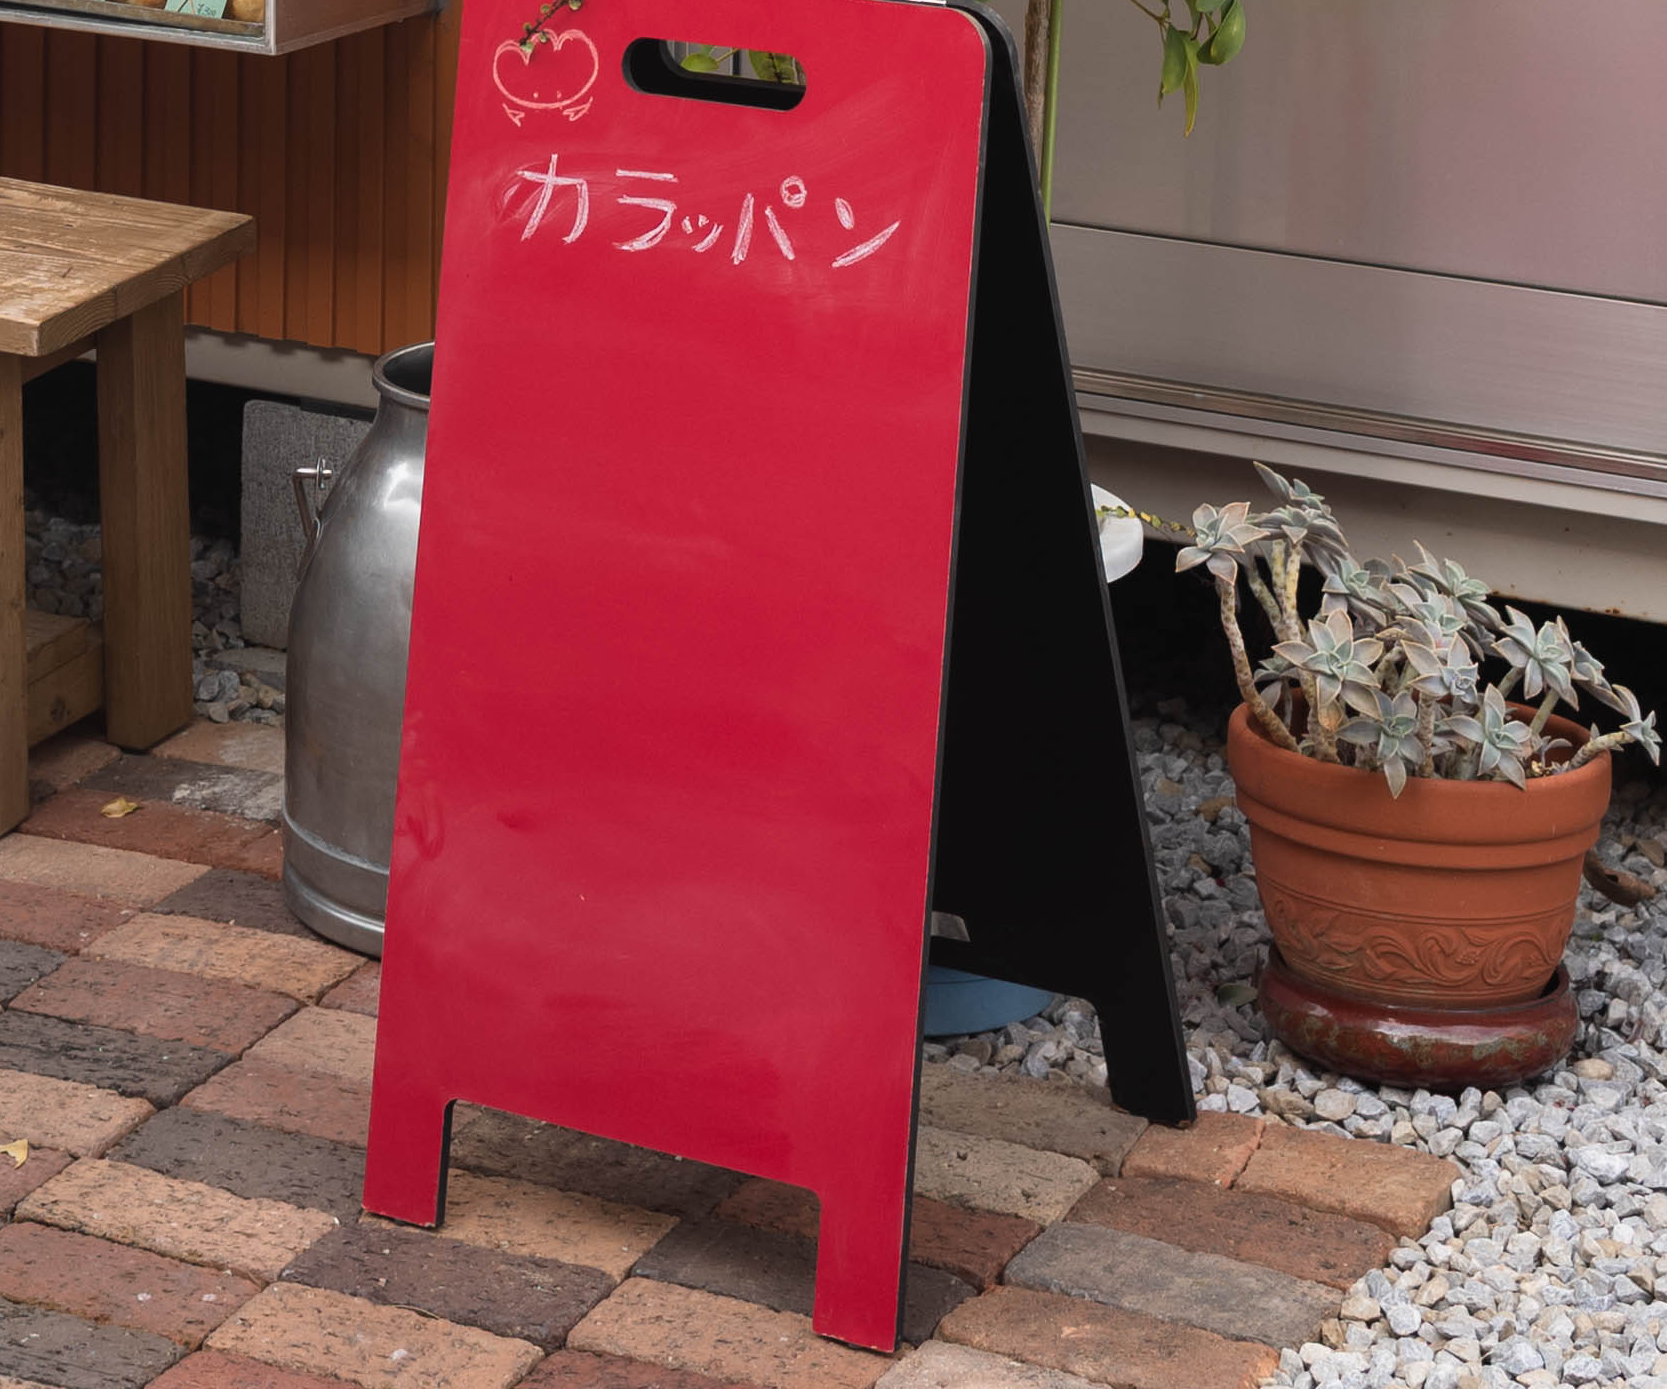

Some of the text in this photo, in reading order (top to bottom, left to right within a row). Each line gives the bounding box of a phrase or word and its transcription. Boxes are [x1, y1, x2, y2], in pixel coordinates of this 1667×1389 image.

[516, 153, 901, 267] カラッパン
